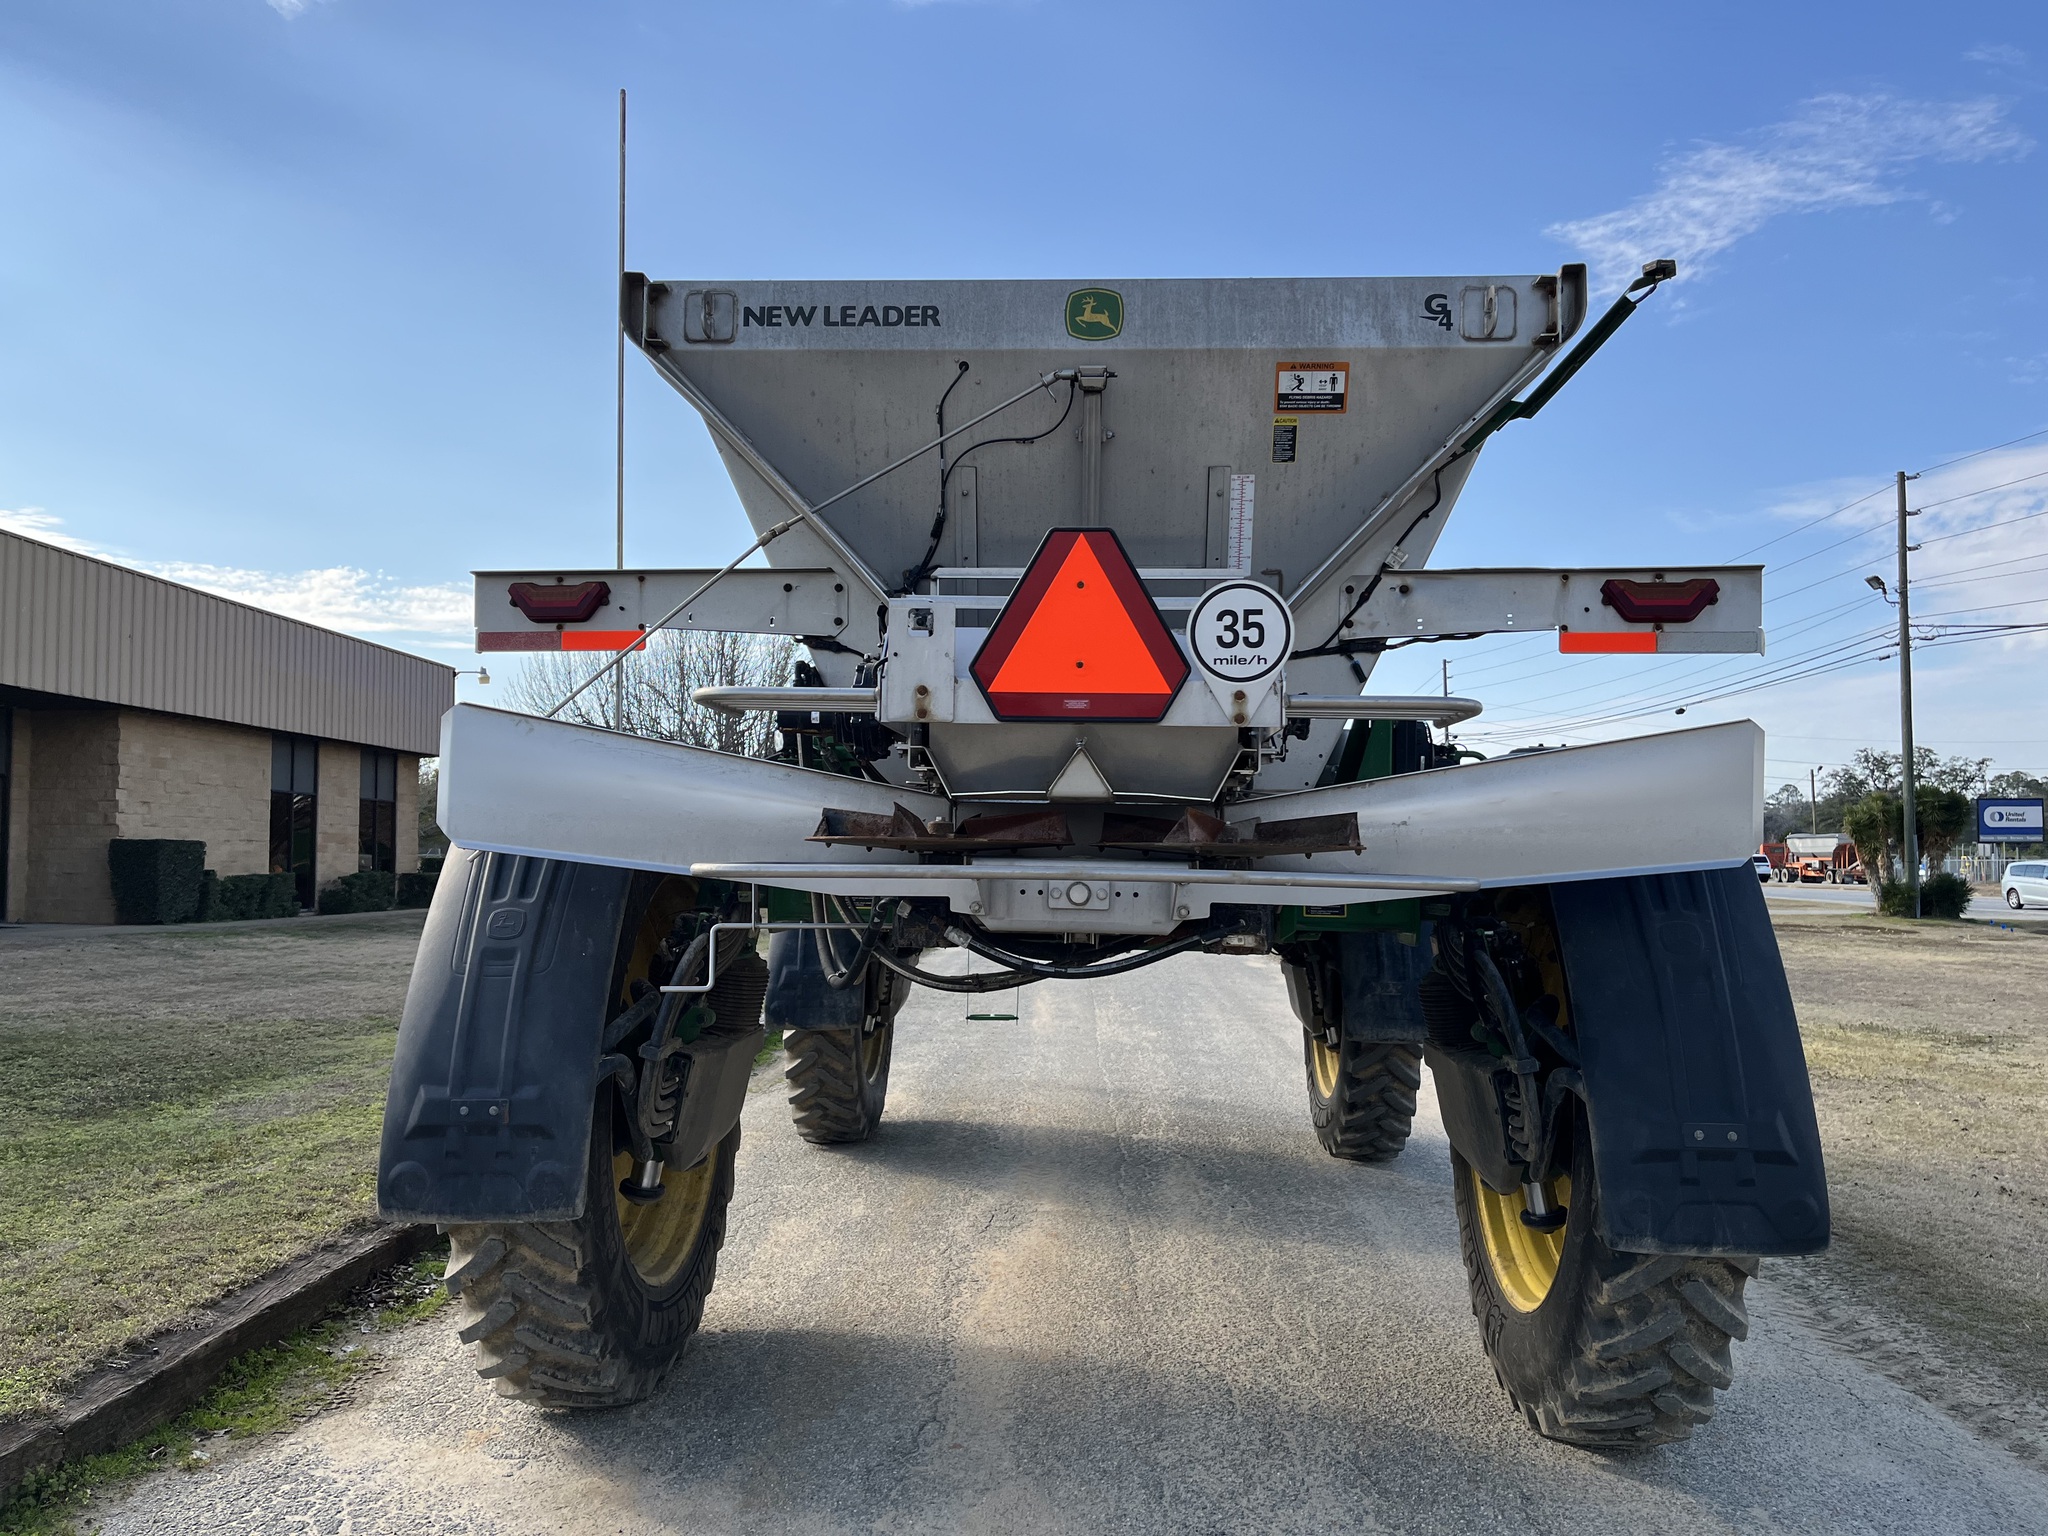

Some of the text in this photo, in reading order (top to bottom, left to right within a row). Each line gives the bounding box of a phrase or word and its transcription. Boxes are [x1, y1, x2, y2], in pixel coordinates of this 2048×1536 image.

[742, 305, 941, 327] NEW LEADER
[1216, 609, 1265, 649] 35
[1213, 655, 1268, 665] mile/h
